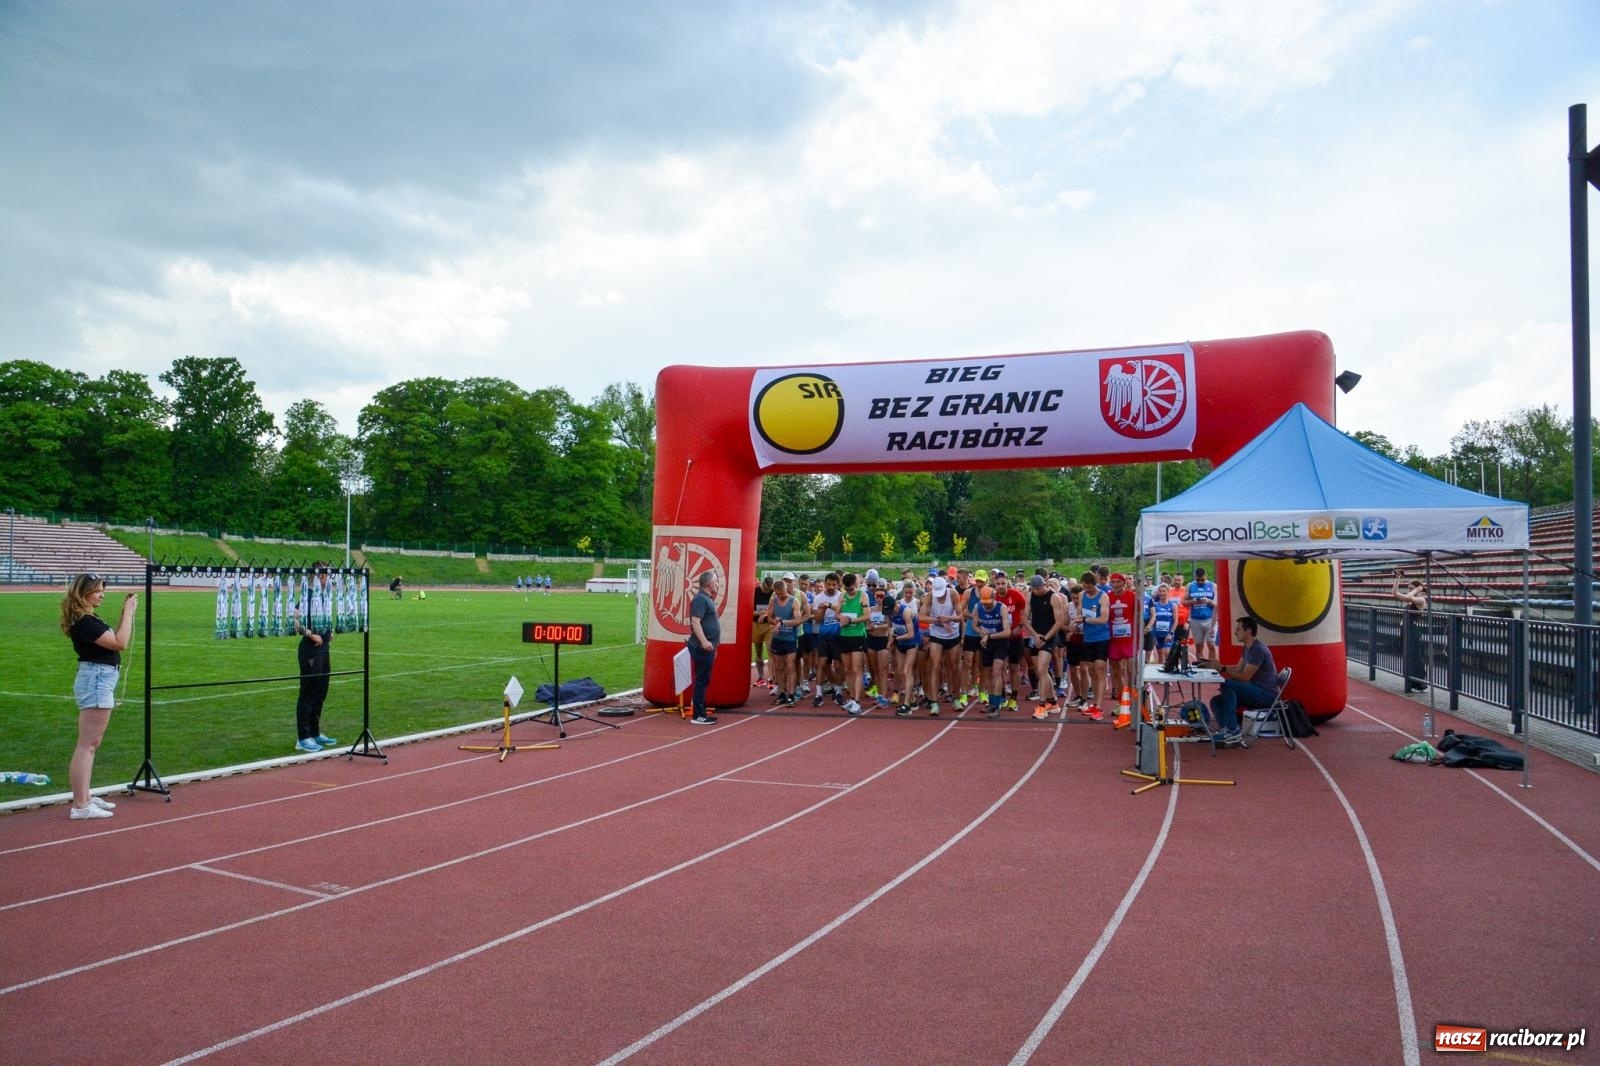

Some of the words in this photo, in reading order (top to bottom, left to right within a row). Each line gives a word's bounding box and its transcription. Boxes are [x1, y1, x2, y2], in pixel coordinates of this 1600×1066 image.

[925, 364, 1005, 384] BIEG
[868, 396, 934, 420] BEZ
[939, 389, 1064, 417] GRANIC
[886, 422, 1049, 451] RACIBÓRZ
[1165, 520, 1301, 542] PersonalBest
[1466, 527, 1504, 538] MITKO
[534, 625, 582, 641] 0:00:00
